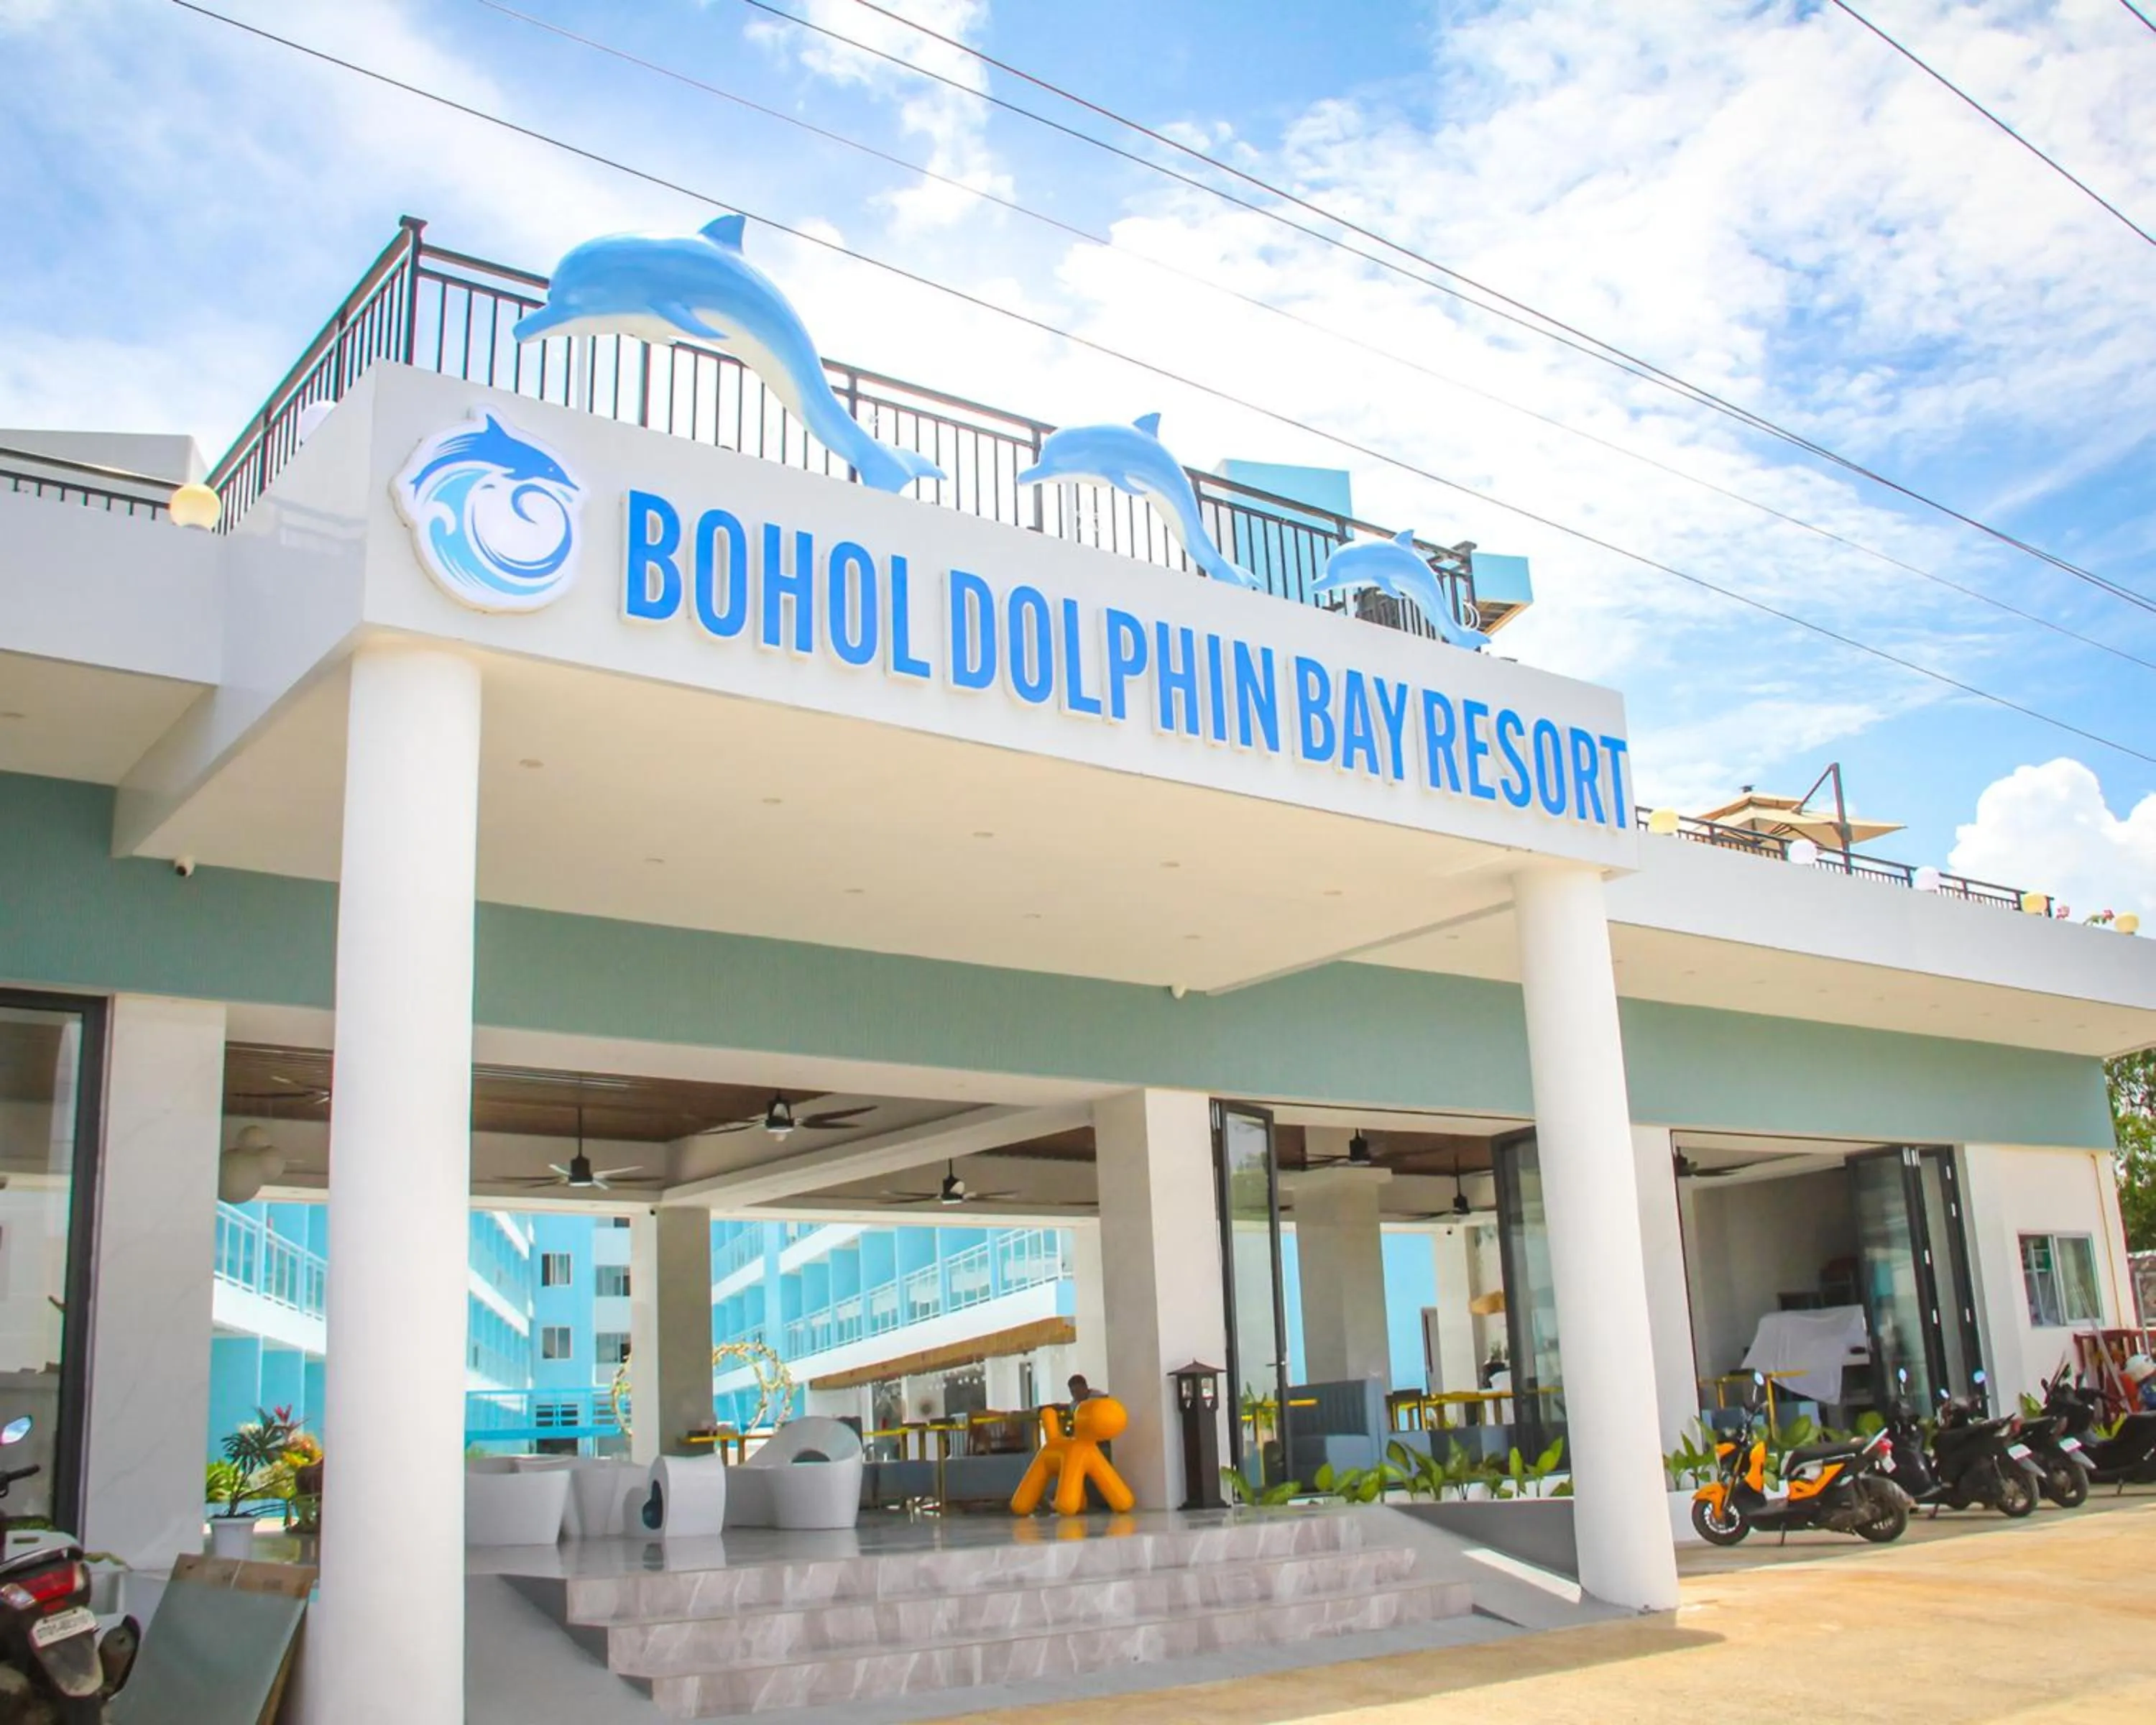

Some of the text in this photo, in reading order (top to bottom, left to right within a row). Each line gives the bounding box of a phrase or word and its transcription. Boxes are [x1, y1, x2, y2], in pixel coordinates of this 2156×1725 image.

[625, 489, 1628, 830] BOHOL DOLPHIN BAY RESORT
